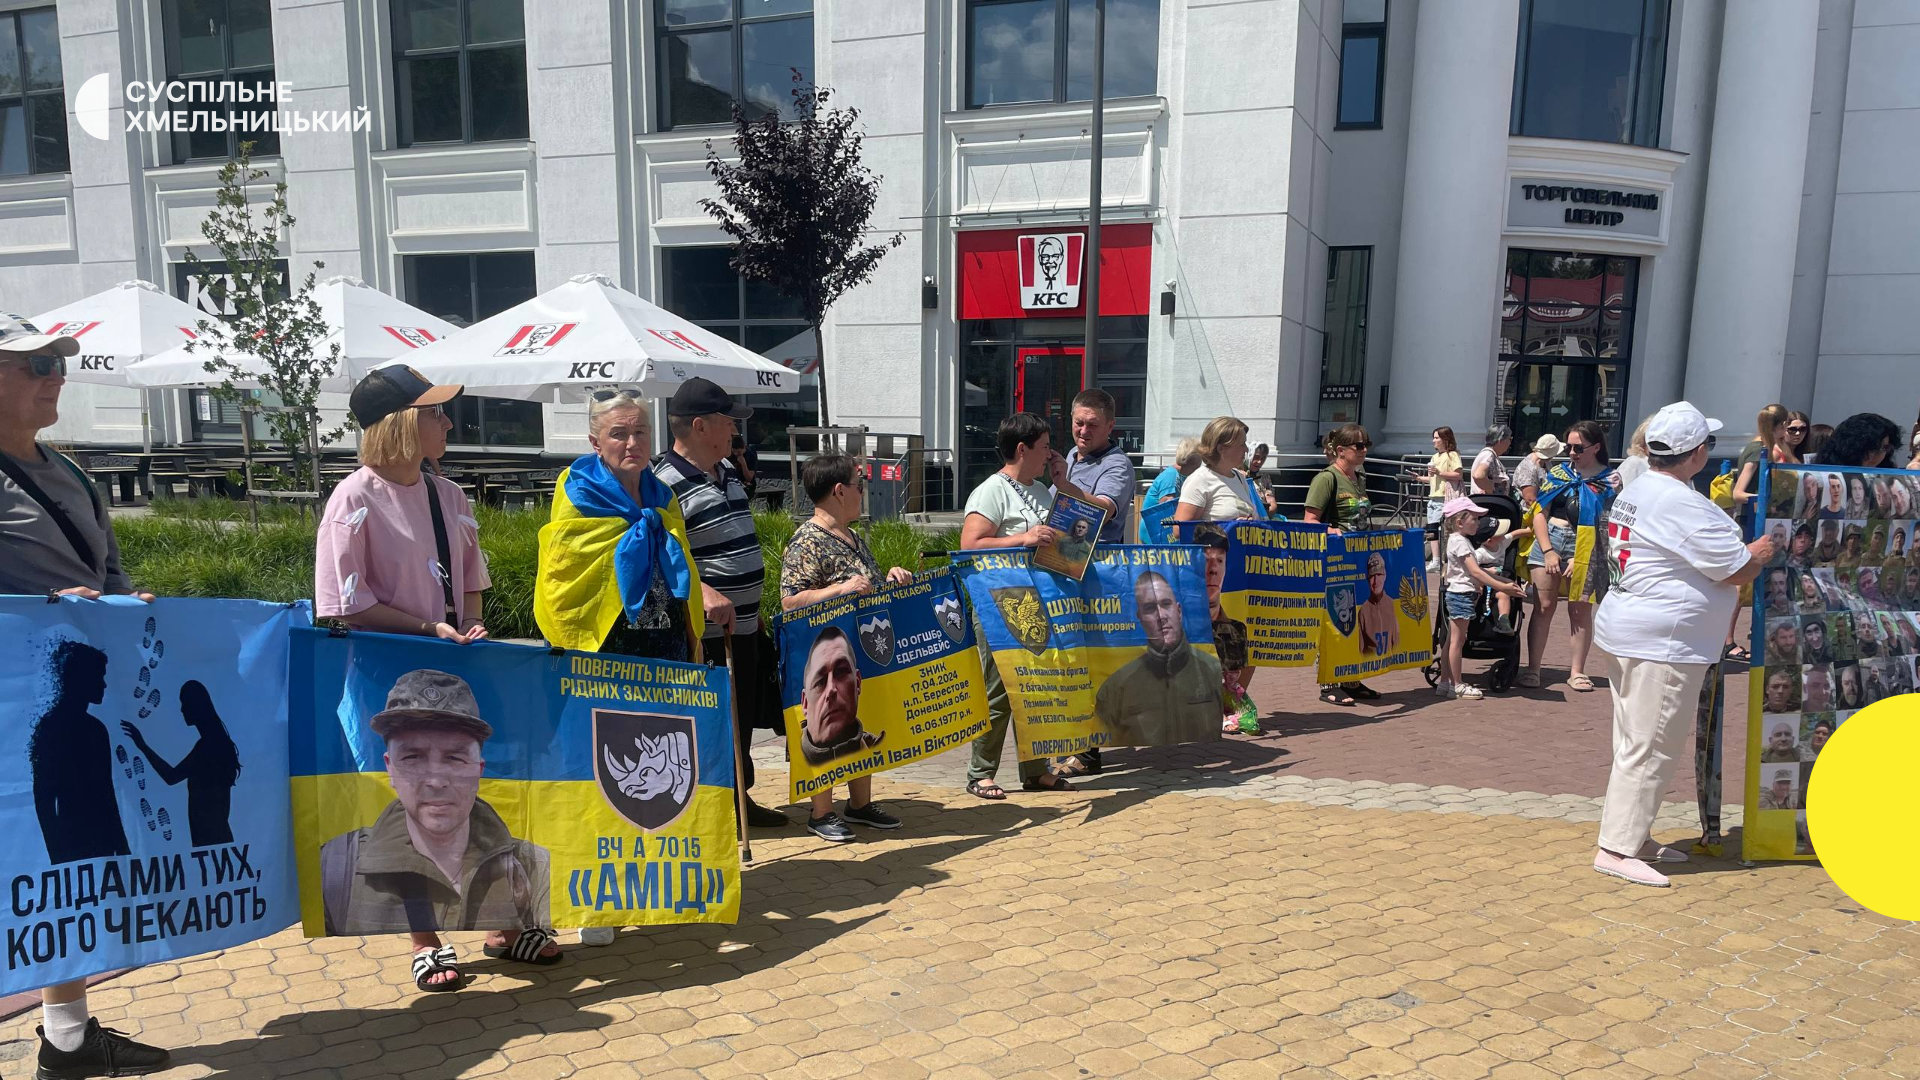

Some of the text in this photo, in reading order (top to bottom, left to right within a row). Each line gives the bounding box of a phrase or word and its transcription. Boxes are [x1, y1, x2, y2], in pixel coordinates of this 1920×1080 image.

[1522, 184, 1659, 210] ТОРГОВЕЛЬНИЙ
[1565, 208, 1624, 226] ЦЕНТР
[1032, 292, 1068, 306] KFC
[80, 354, 115, 371] KFC
[504, 347, 543, 355] KFC
[567, 361, 616, 379] KFC
[756, 370, 781, 387] KFC
[1236, 526, 1288, 549] ЧЕМЕРИС
[1131, 547, 1192, 566] ЗАБУТИЙ!
[782, 603, 823, 624] БЕЗВІСТИ
[808, 603, 857, 628] НАДІЄМОСЬ,
[893, 583, 932, 600] ЧЕКАЄМО
[1255, 616, 1289, 627] безвісти
[896, 640, 951, 665] ЕДЕЛЬВЕЙС
[897, 637, 909, 649] 10
[1375, 631, 1389, 656] 37
[571, 656, 708, 688] ПОВЕРНІТЬ НАШИХ
[919, 662, 947, 678] ЗНИК
[1014, 666, 1029, 677] 158
[560, 677, 719, 709] РІДНИХ ЗАХИСНИКІВ!
[910, 670, 958, 694] 17.04.2024
[1019, 683, 1025, 693] 2
[903, 680, 970, 708] н.п. Берестове
[906, 691, 971, 721] Донецька обл.
[910, 711, 958, 735] 18.06.1977
[795, 718, 987, 796] Поперечний Іван Вікторович
[1032, 738, 1073, 756] ПОВЕРНІТЬ
[597, 836, 701, 859] ВЧ А 7015
[11, 843, 263, 918] СЛІДАМИ ТИХ,
[568, 861, 725, 914] «АМІД»
[7, 885, 268, 971] КОГО ЧЕКАЮТЬ
